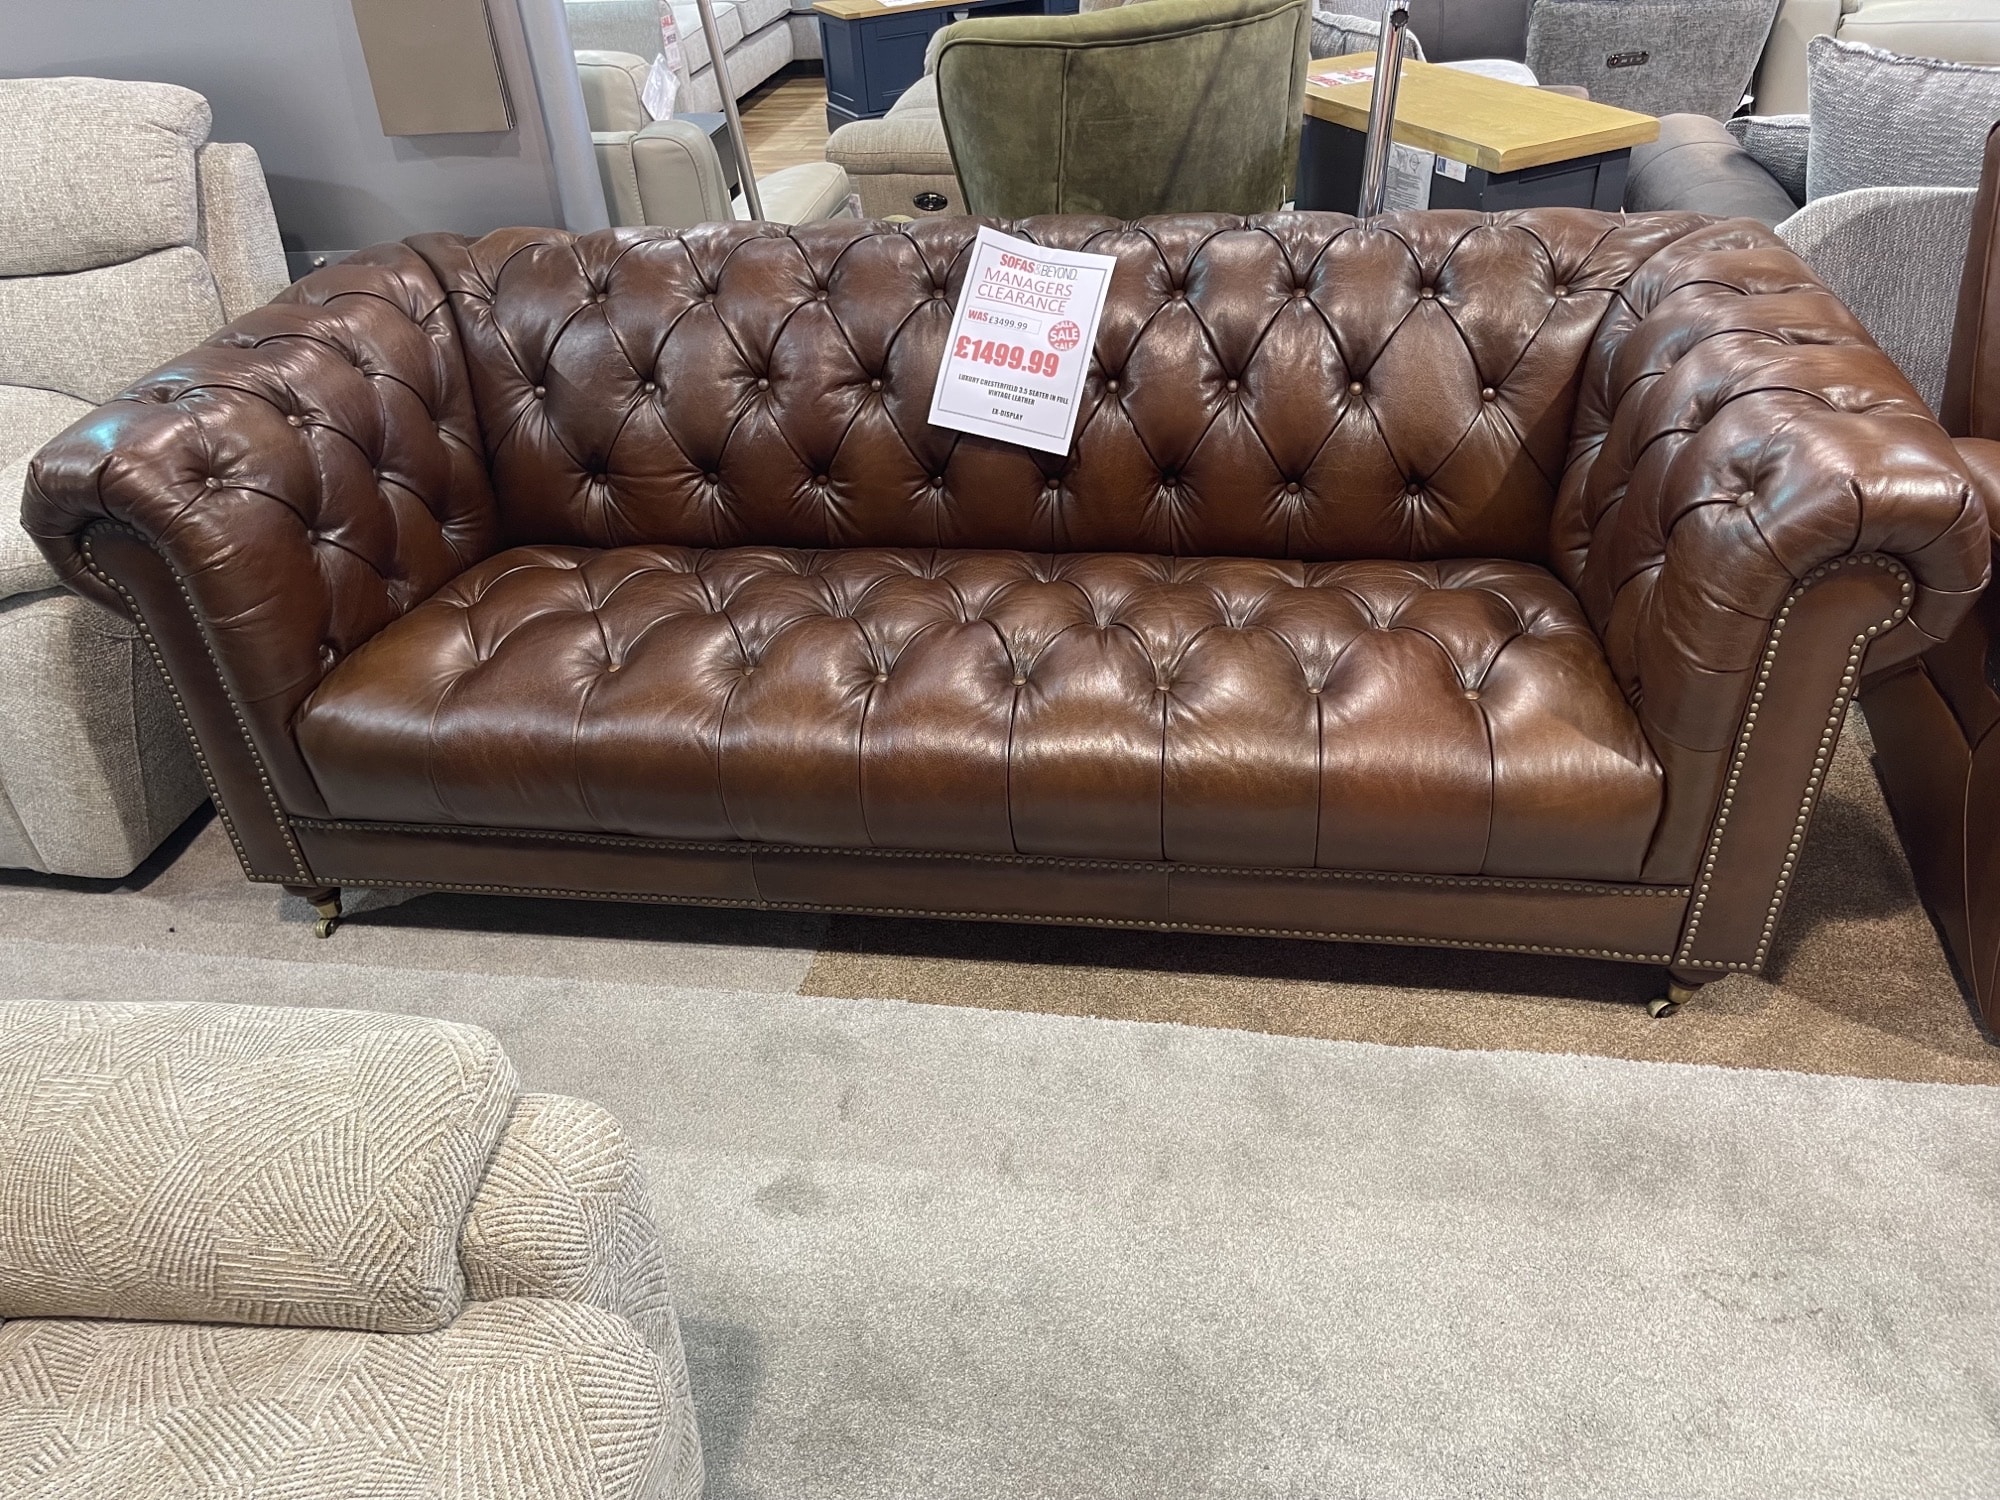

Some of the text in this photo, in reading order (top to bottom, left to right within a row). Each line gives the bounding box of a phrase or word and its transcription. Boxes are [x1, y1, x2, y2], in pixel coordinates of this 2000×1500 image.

[984, 266, 1073, 297] MANAGERS
[977, 283, 1067, 313] CLEARANCE
[968, 309, 1028, 330] WAS £3499.99
[1050, 328, 1079, 342] SALE
[954, 335, 1060, 378] £1499.99
[958, 373, 980, 385] LUXURY
[980, 378, 1019, 393] CHESTERFIELD
[1019, 386, 1028, 395] 3.5
[1028, 389, 1050, 401] SEATER
[1057, 395, 1069, 405] FULL
[988, 389, 1036, 406] VINTAGE LEATHER
[991, 407, 1024, 421] EX-DISPLAY
